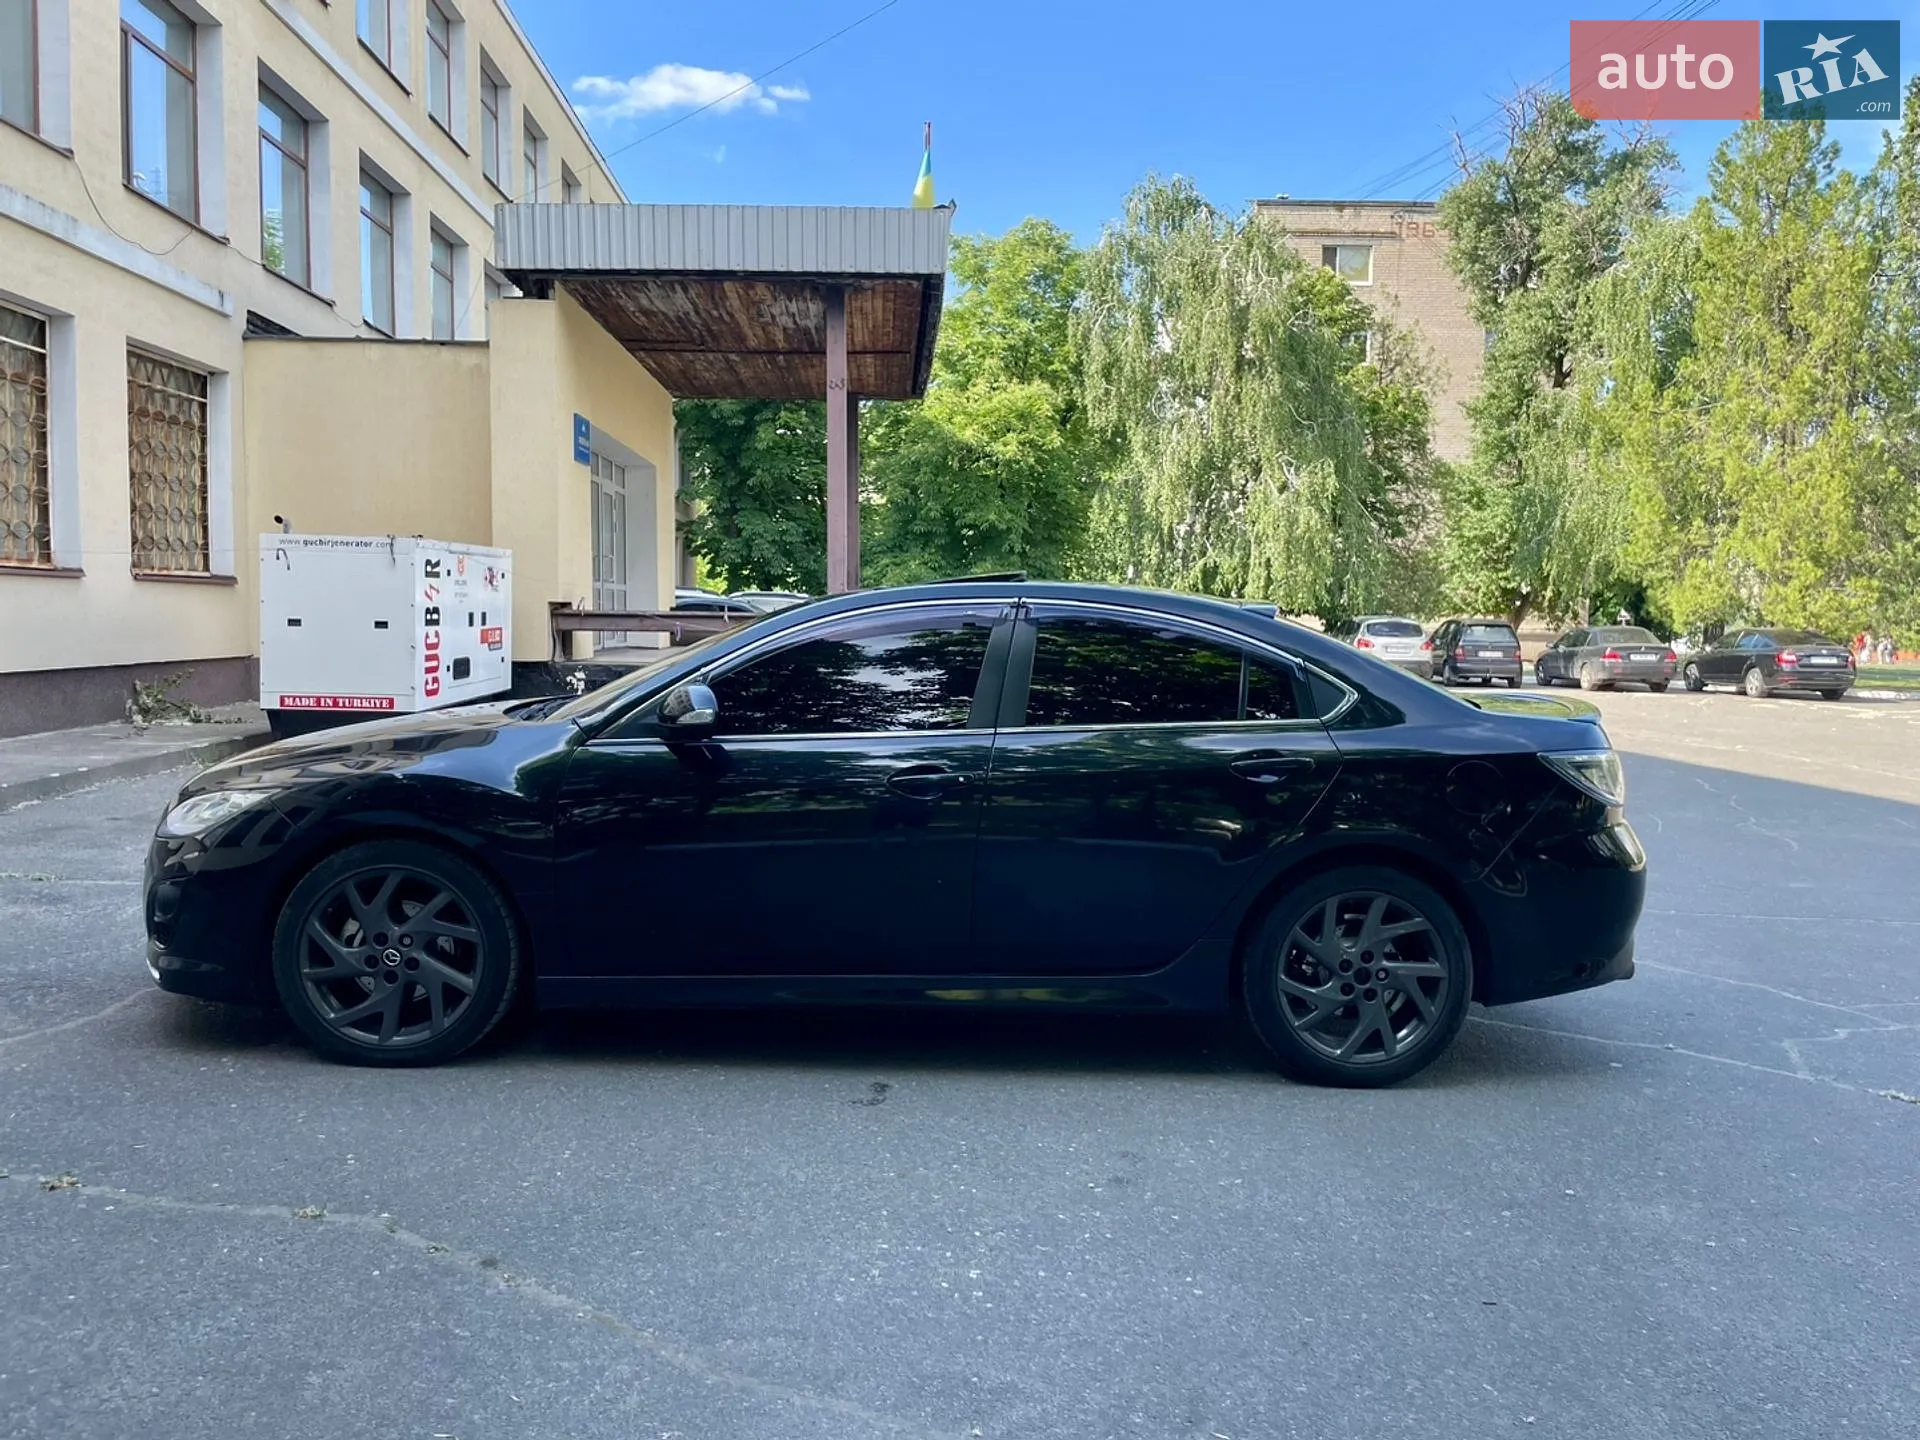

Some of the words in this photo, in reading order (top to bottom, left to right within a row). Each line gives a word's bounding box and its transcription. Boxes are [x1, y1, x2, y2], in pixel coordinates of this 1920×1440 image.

[284, 696, 317, 707] MADE
[320, 697, 334, 707] IN
[336, 697, 390, 708] TURKIYE
